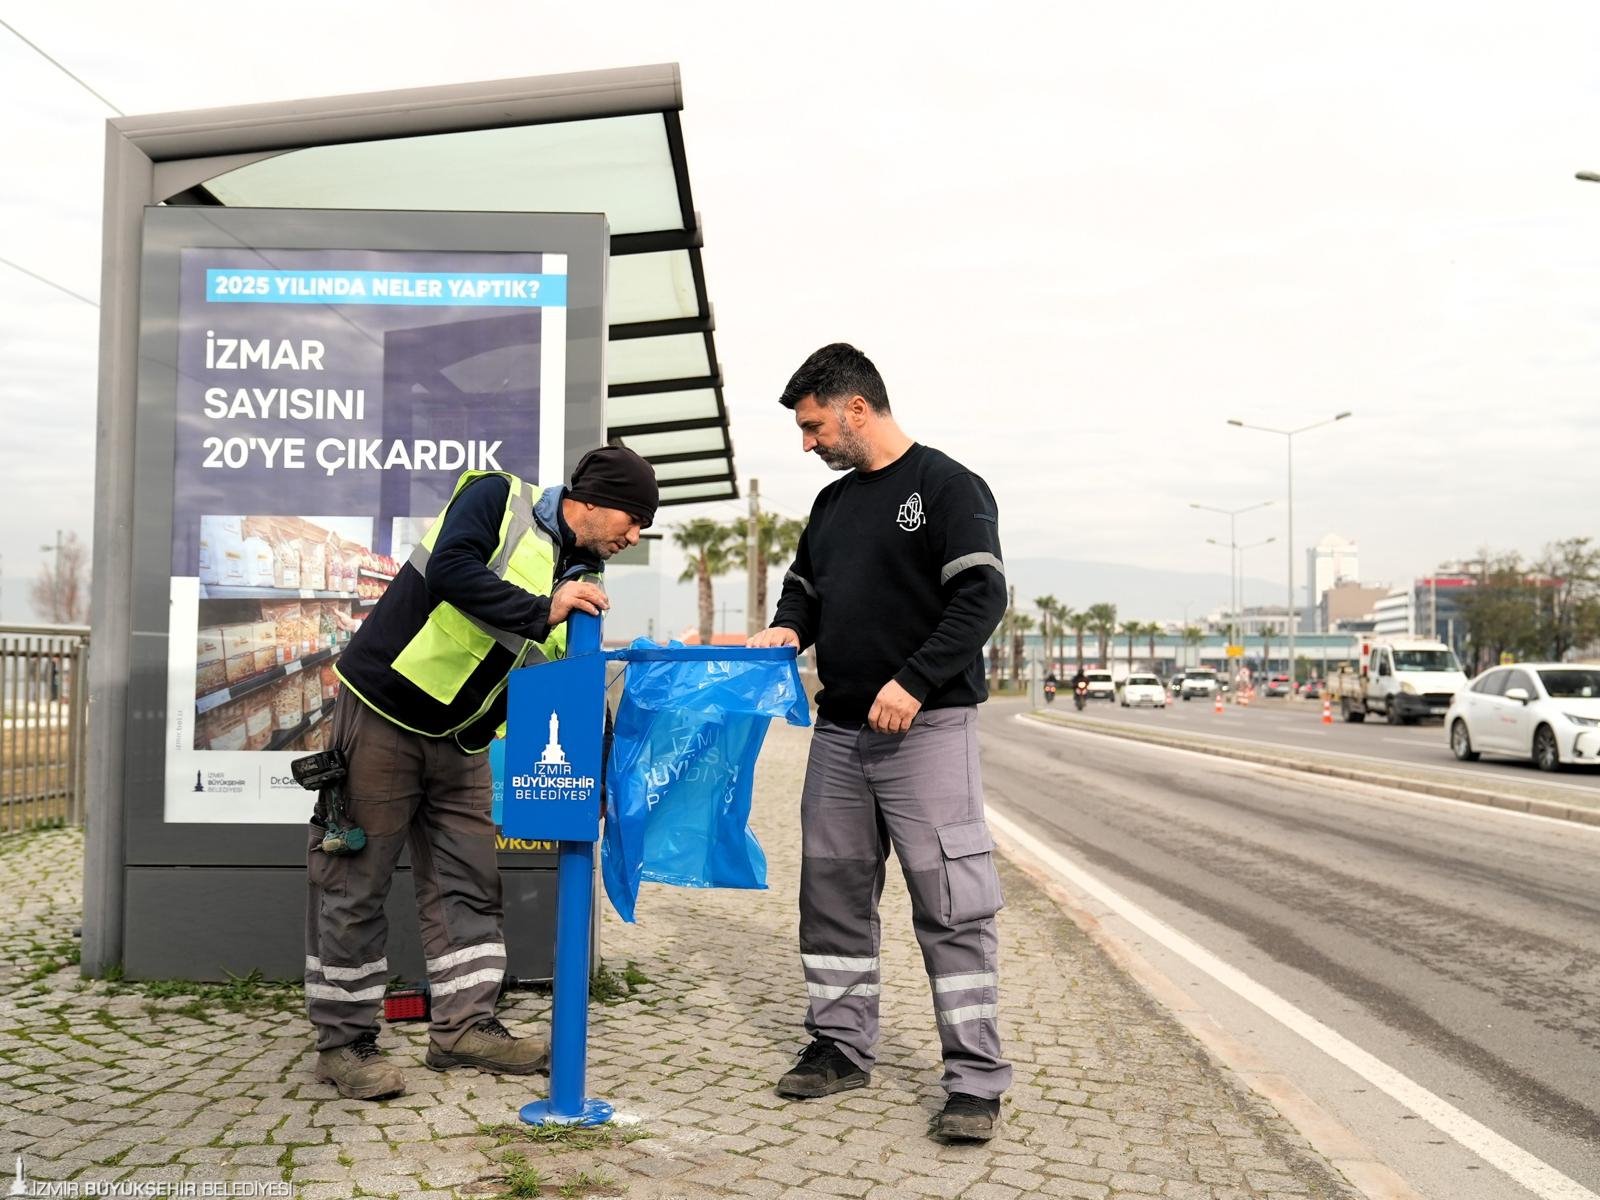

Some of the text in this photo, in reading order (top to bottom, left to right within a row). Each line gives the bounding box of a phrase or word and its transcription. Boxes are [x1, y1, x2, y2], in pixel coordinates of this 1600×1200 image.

[215, 275, 541, 299] 2025 YILINDA NELER YAPTIK?
[205, 329, 325, 370] İZMAR
[203, 387, 365, 420] SAYISINI
[202, 437, 503, 476] 20'YE ÇIKARDIK
